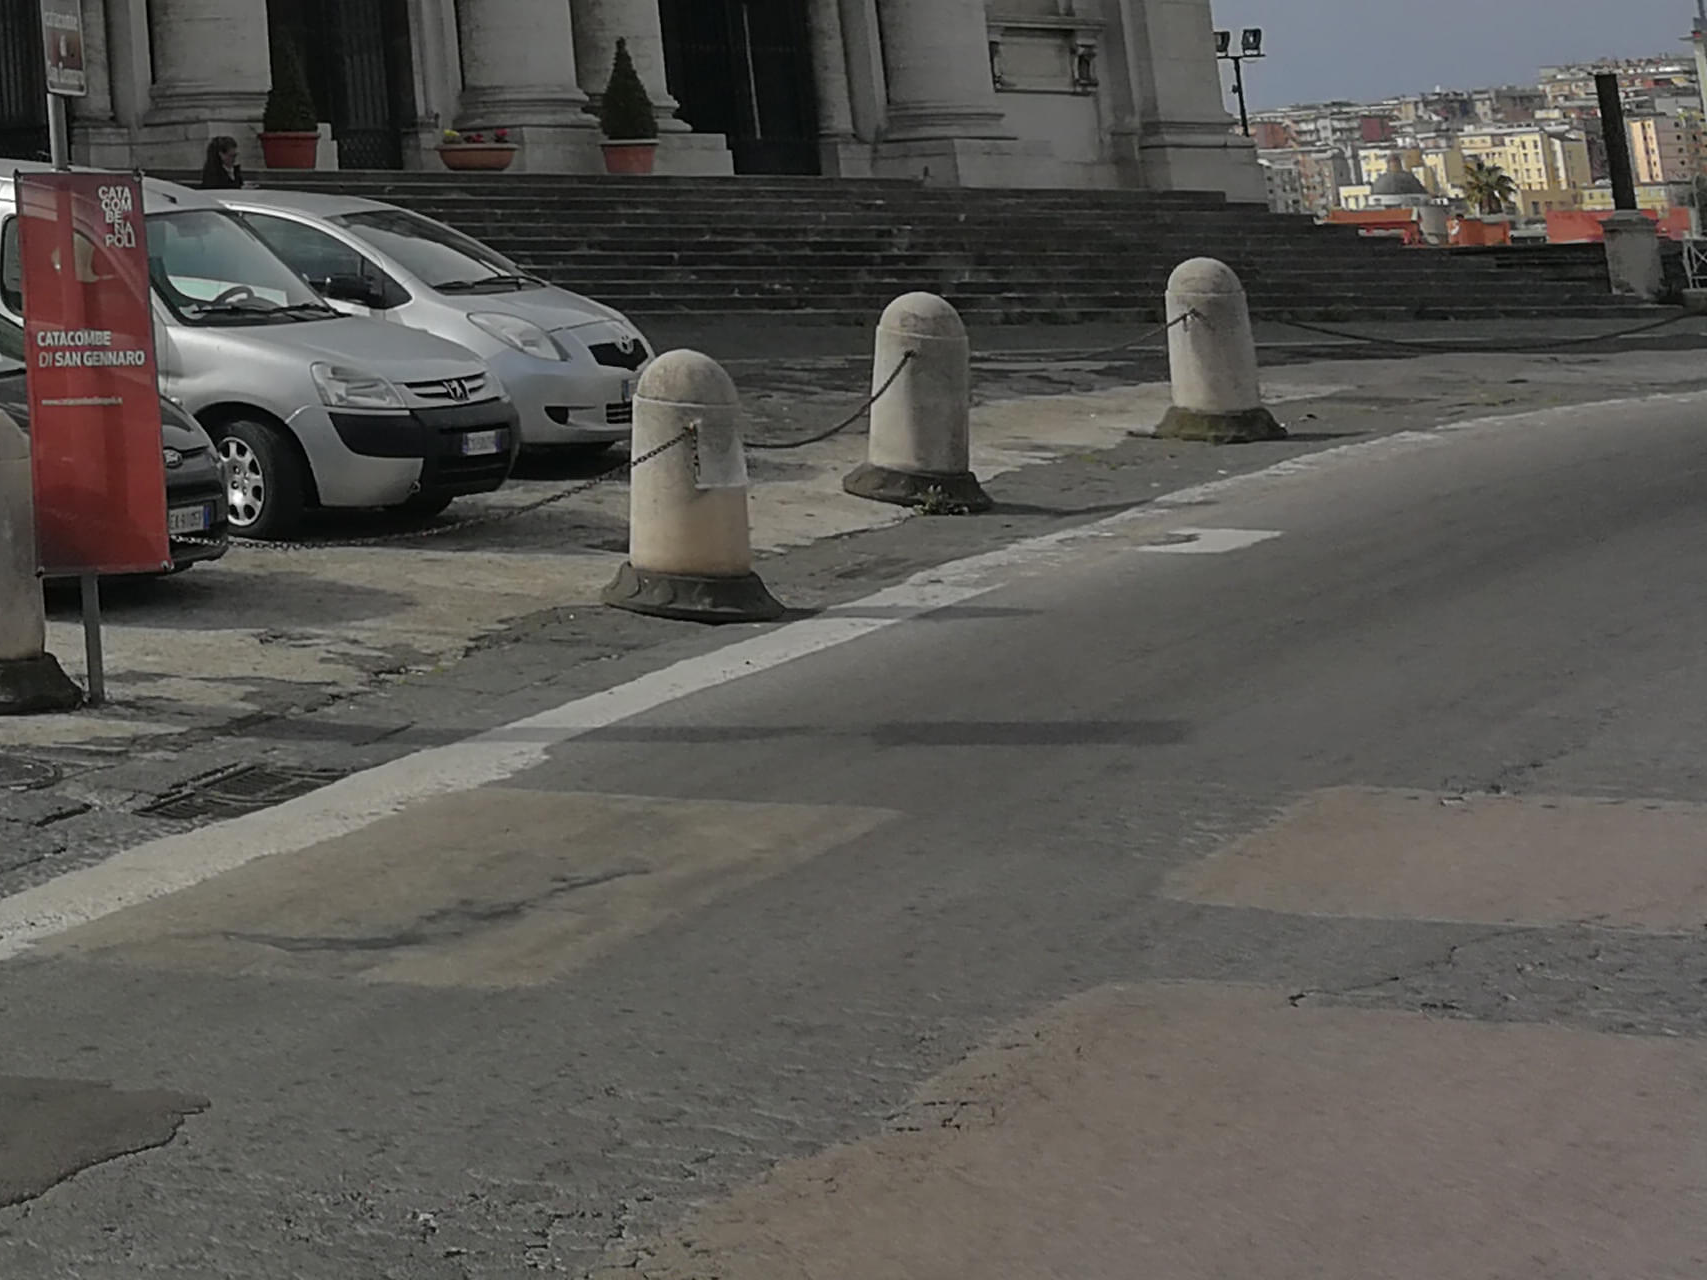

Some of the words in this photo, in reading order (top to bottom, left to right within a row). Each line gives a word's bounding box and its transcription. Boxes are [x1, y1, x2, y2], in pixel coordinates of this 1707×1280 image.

[98, 185, 132, 201] CATA
[101, 198, 132, 212] COM
[36, 330, 112, 347] CATACOMBE
[38, 351, 53, 369] DI
[54, 351, 82, 368] SAN
[82, 350, 146, 367] GENNARO
